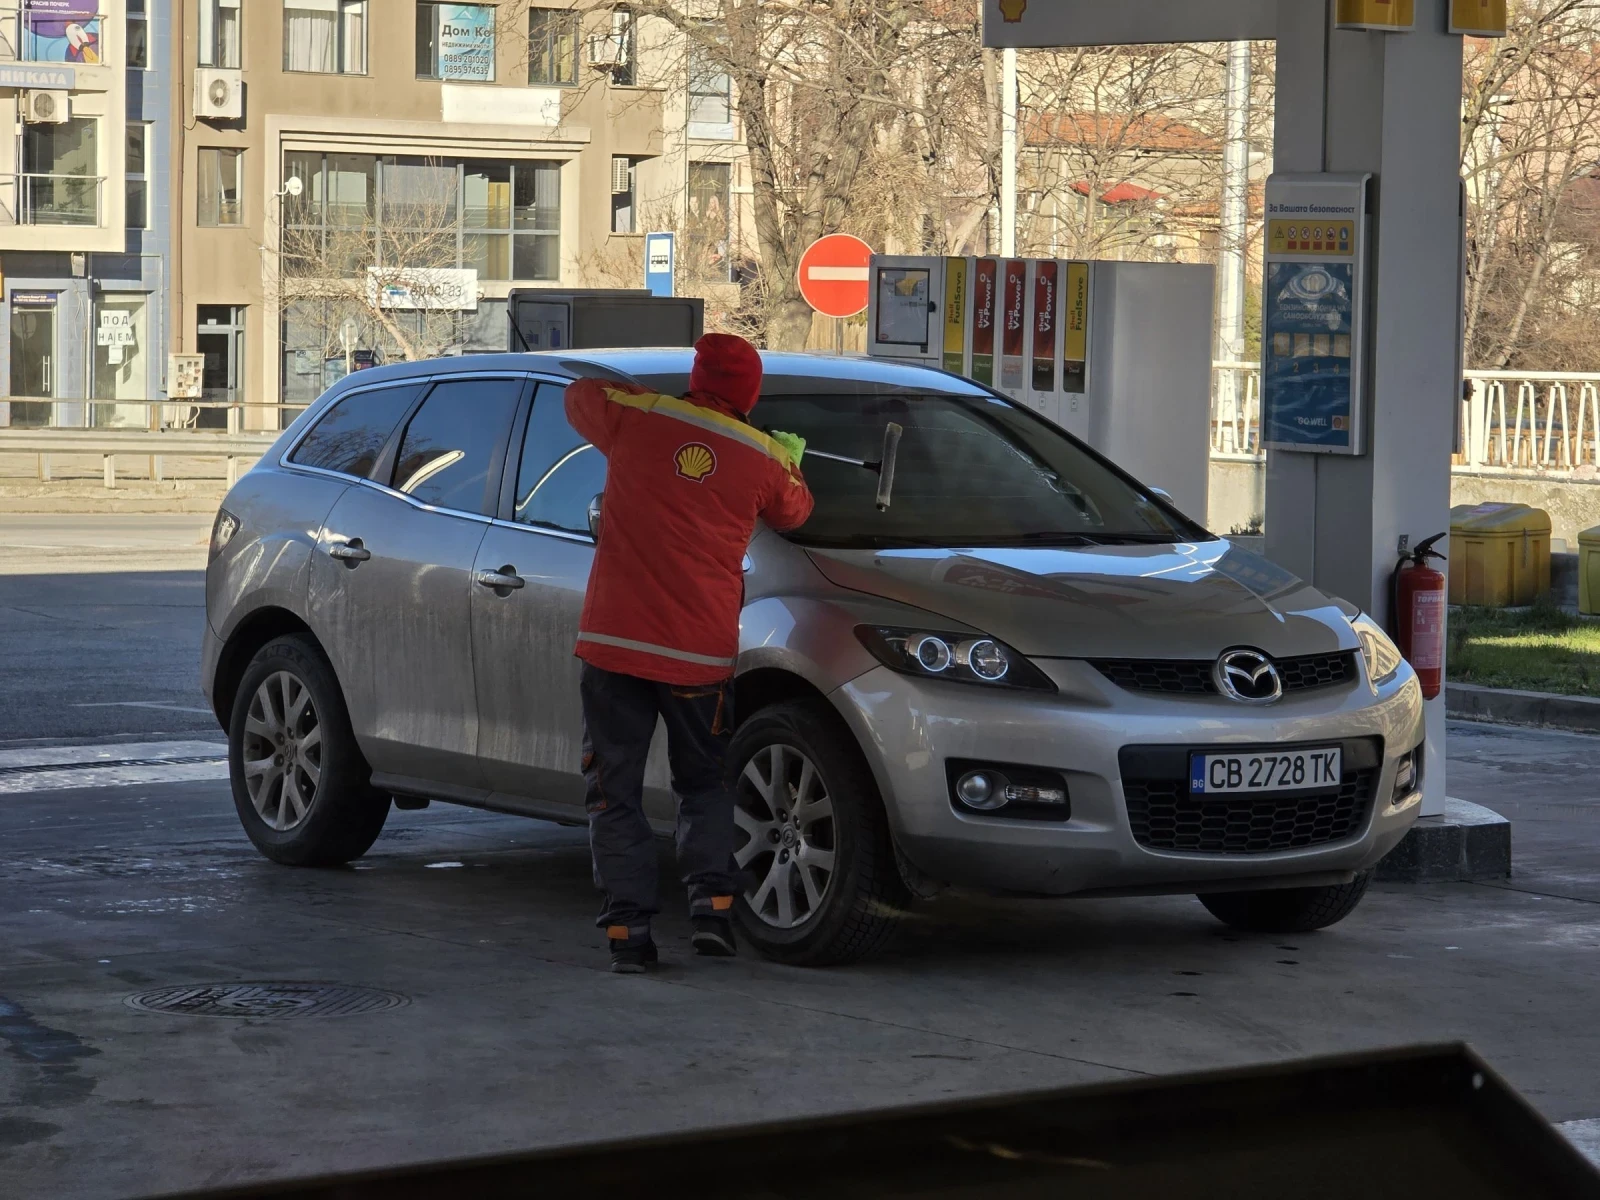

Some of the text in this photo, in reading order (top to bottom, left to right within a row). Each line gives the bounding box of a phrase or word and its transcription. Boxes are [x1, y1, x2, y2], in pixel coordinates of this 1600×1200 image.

[442, 25, 470, 38] Дом
[444, 54, 462, 62] 0889
[444, 65, 462, 73] 0895
[1268, 203, 1355, 214] За Вашата безопасност
[953, 271, 962, 324] FuelSave
[982, 277, 992, 329] V-Power
[1012, 278, 1022, 330] V-Power
[1075, 277, 1084, 331] FuelSave
[1043, 280, 1053, 332] V-Power
[103, 315, 129, 326] ПОД
[98, 332, 135, 342] НАЕМ
[1210, 752, 1336, 788] CB 2728 TK
[1192, 780, 1204, 789] BG
